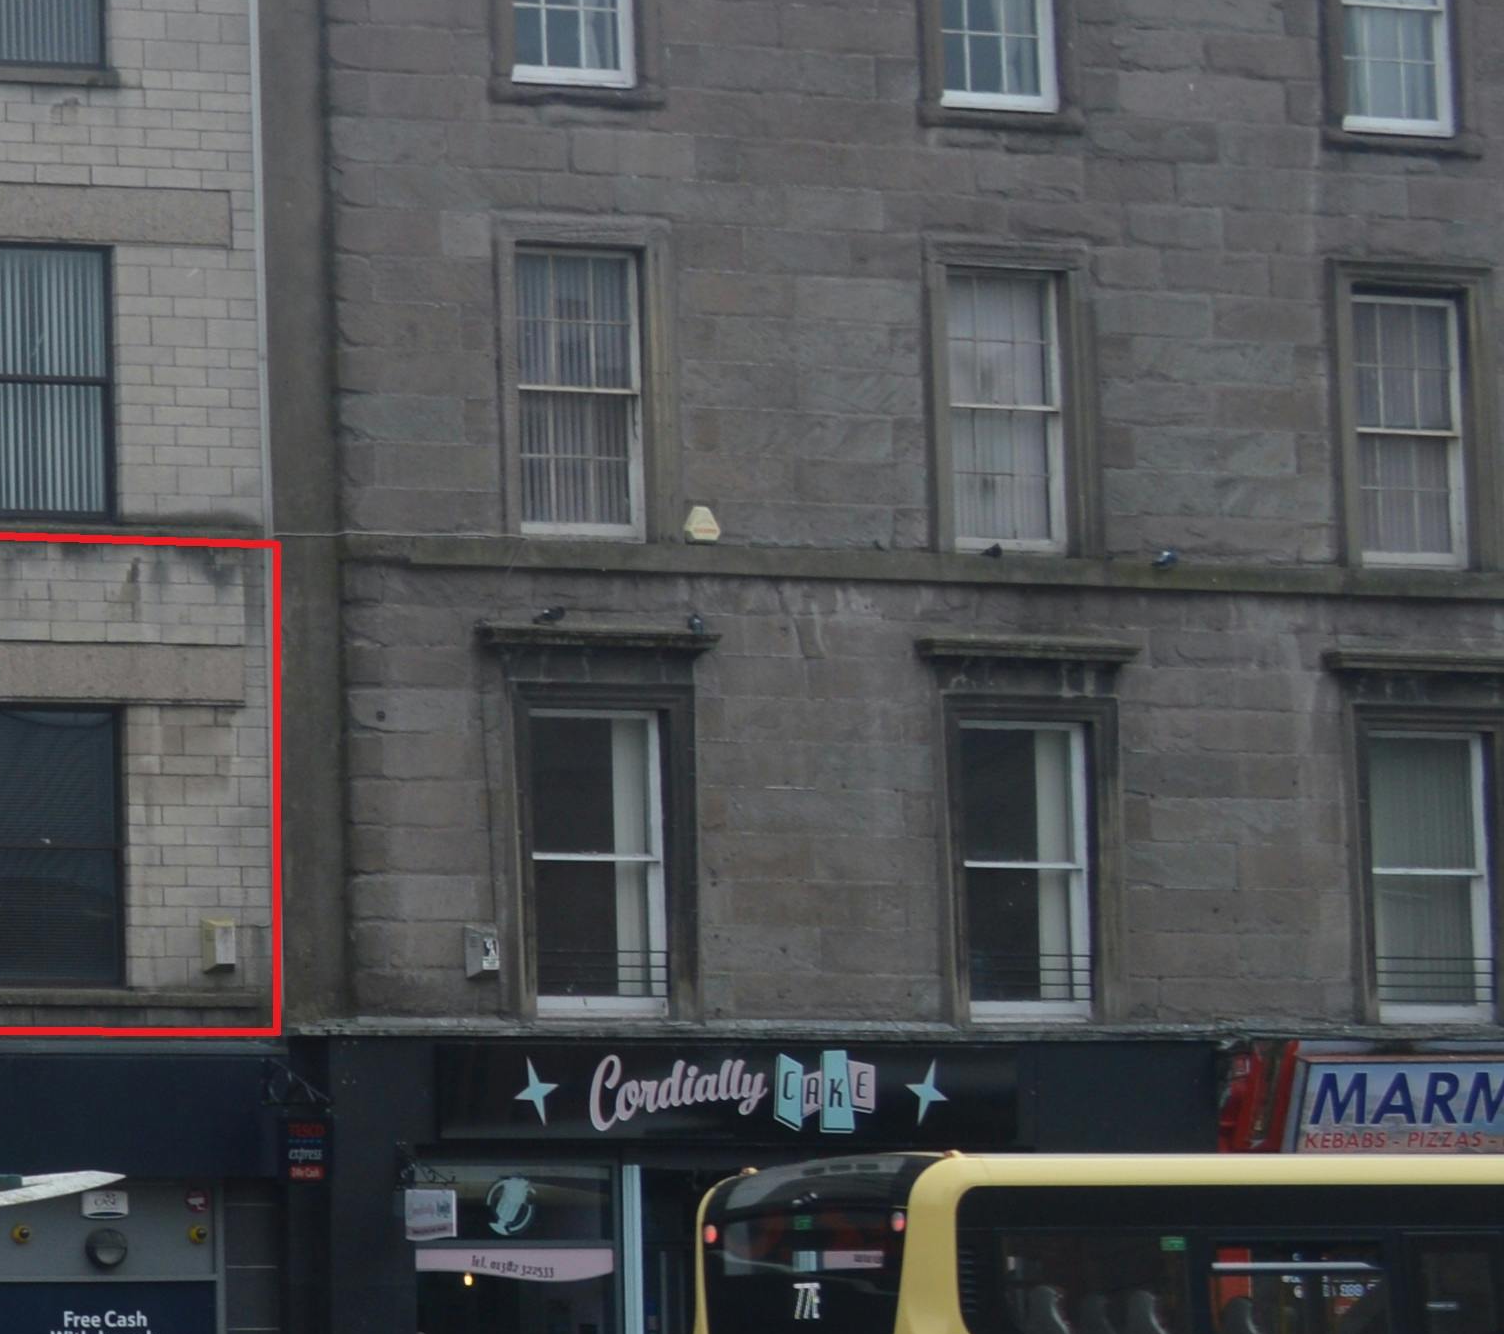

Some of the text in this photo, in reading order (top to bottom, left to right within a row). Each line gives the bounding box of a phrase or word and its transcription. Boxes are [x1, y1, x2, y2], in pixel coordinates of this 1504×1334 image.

[590, 1054, 868, 1131] Cordially CAKE
[1305, 1132, 1481, 1149] KEBABS PIZZAS
[63, 1310, 148, 1328] Free Cash
